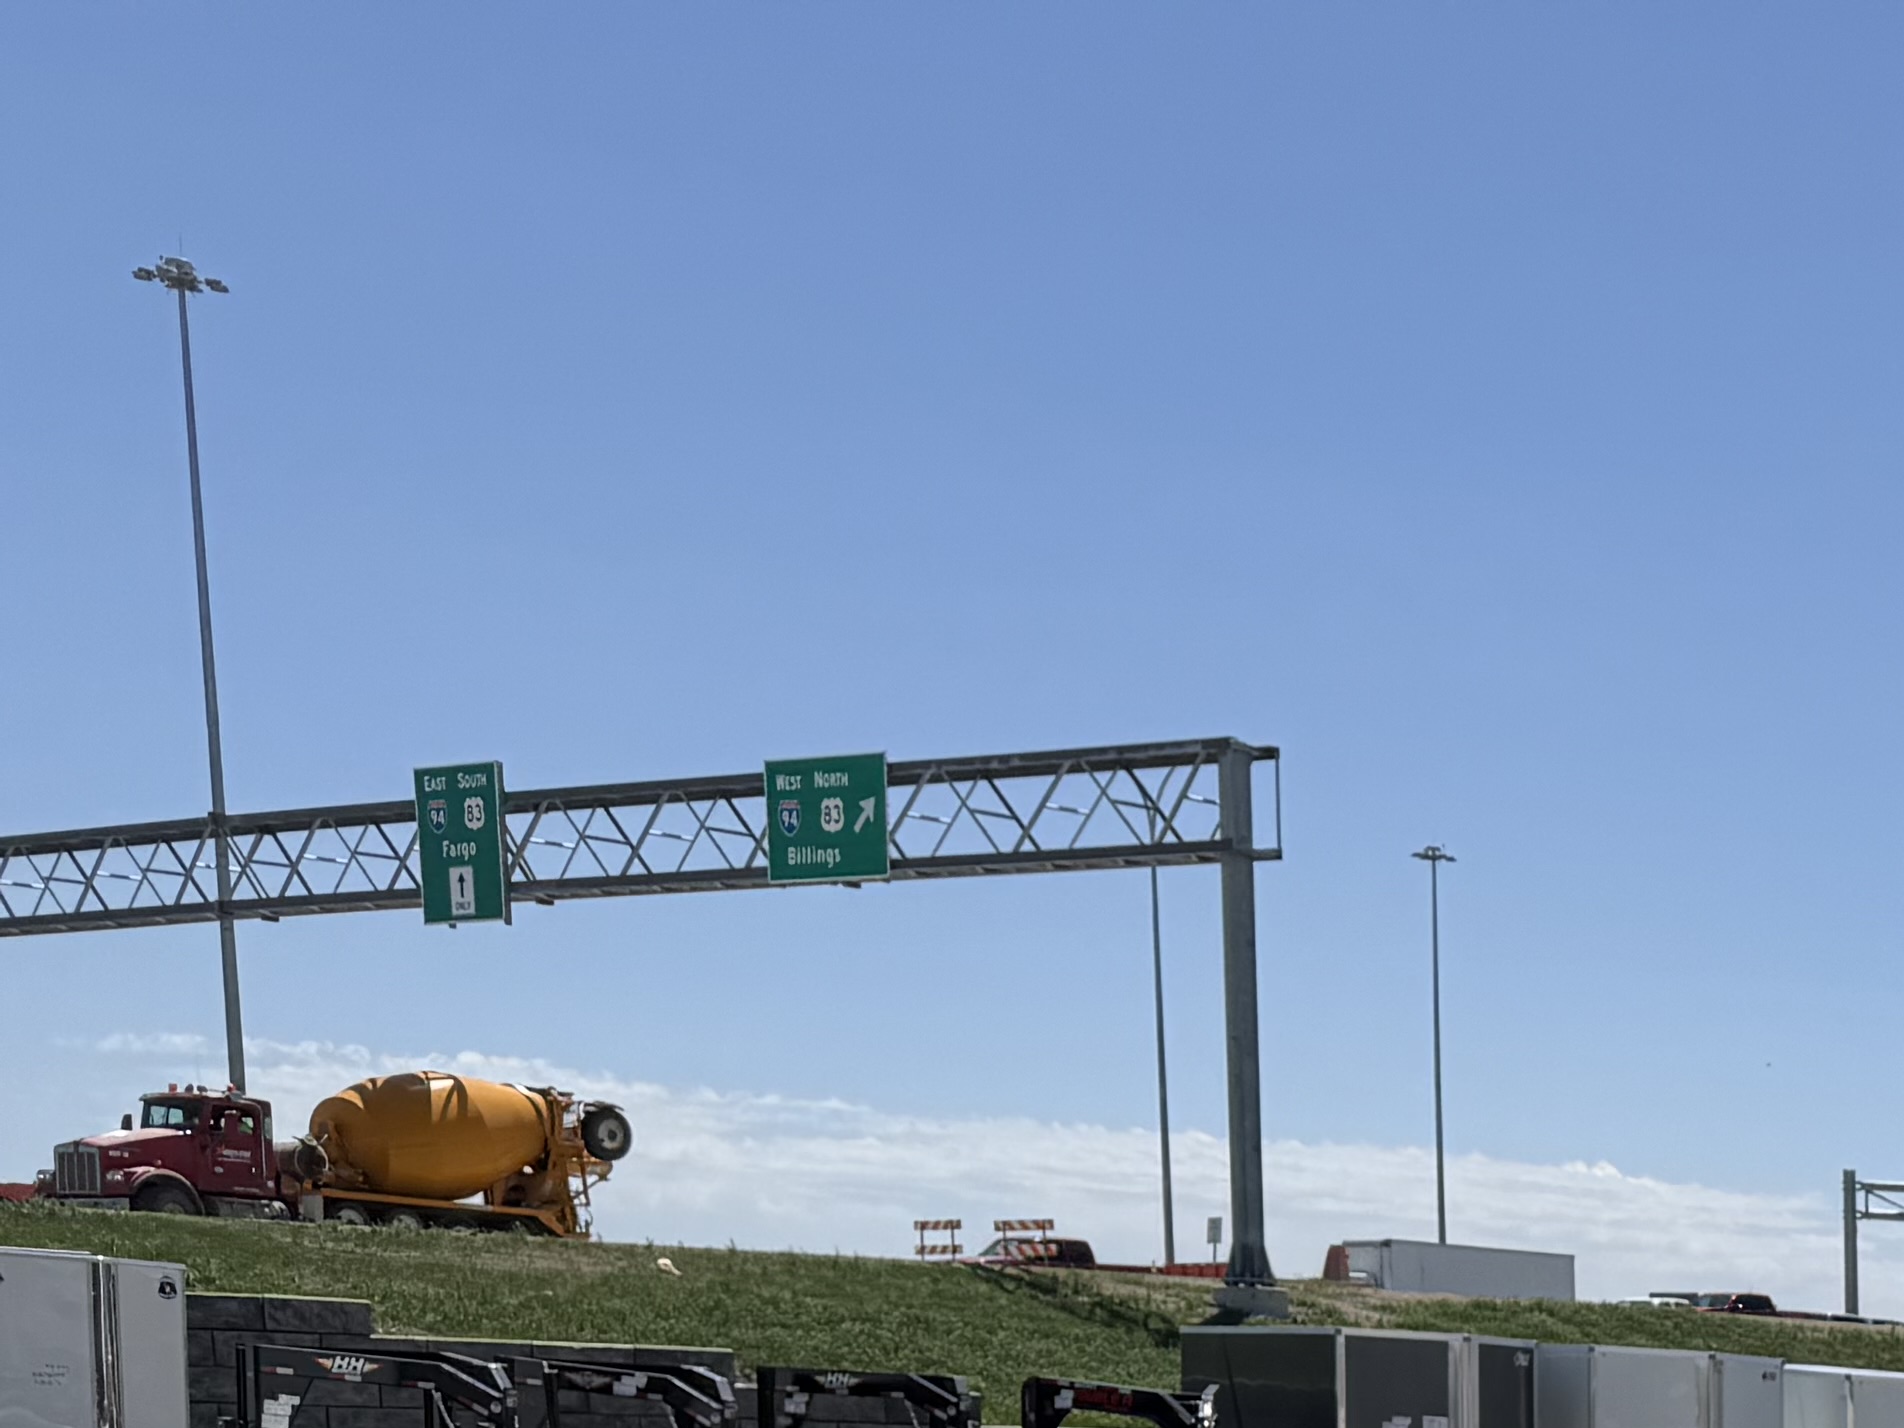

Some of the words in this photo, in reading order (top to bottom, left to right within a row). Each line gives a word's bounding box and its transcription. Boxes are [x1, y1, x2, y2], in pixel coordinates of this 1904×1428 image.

[424, 776, 446, 792] EAST
[457, 773, 487, 789] SOUTH
[775, 774, 802, 791] WEST
[814, 771, 849, 788] NORTH
[430, 810, 445, 825] 94
[466, 803, 483, 822] 83
[781, 810, 798, 828] 94
[823, 804, 841, 825] 83
[442, 840, 477, 861] Fargo
[787, 845, 841, 869] Billings
[455, 901, 471, 911] ONLY
